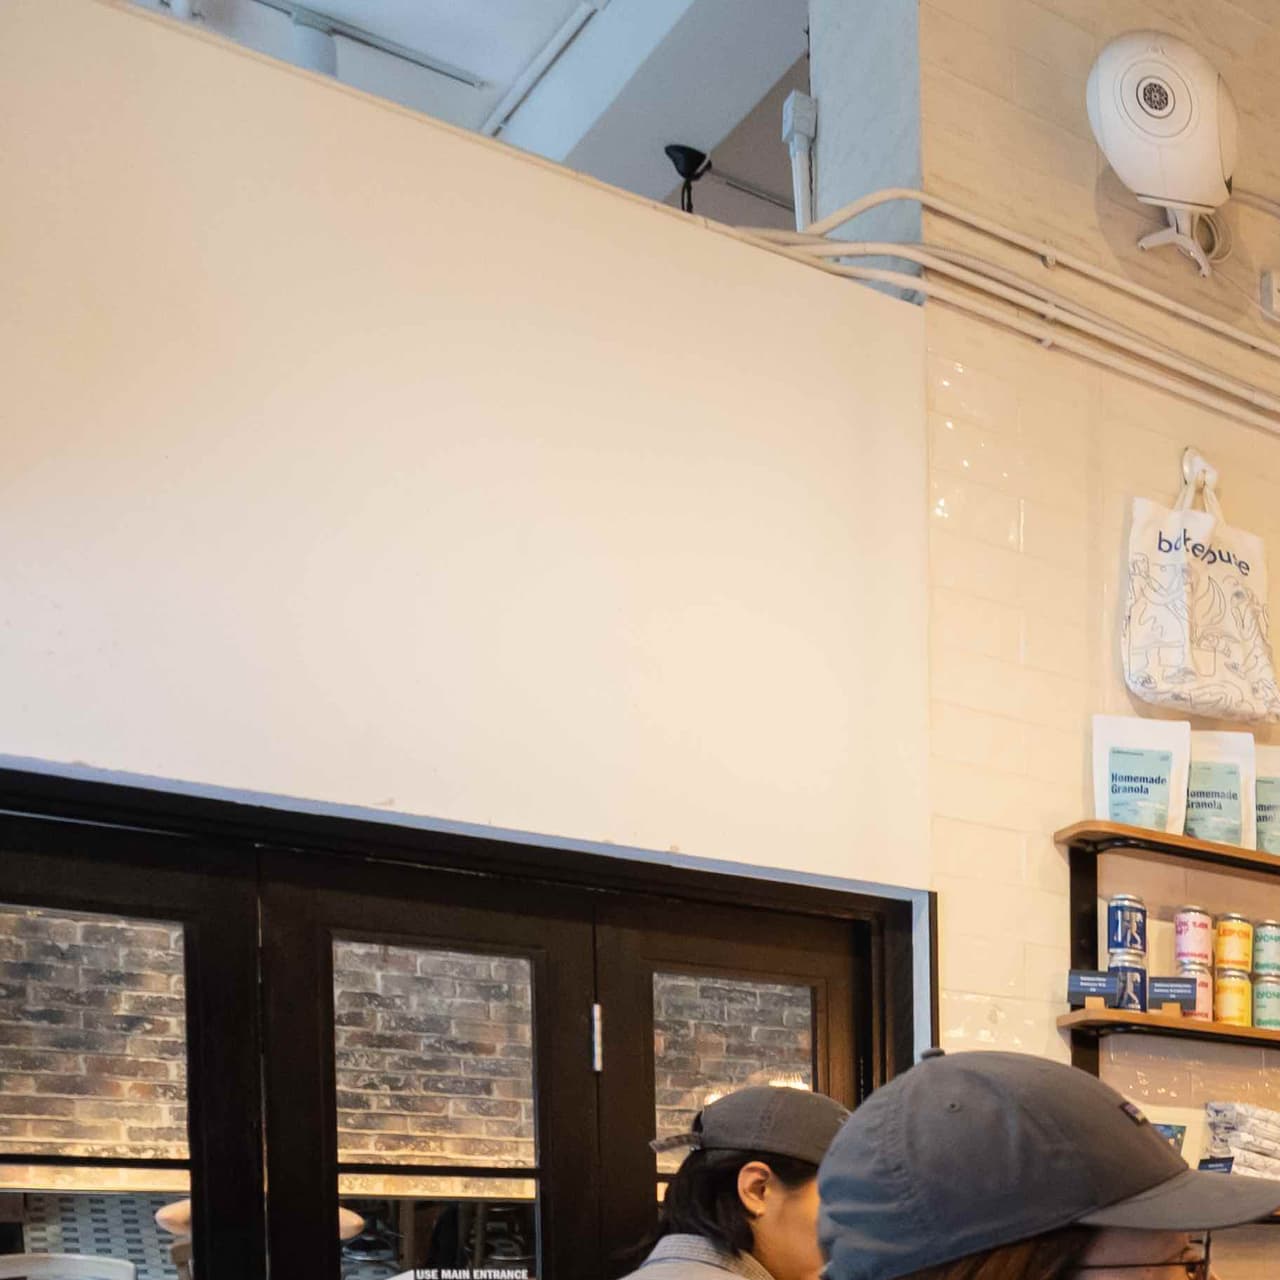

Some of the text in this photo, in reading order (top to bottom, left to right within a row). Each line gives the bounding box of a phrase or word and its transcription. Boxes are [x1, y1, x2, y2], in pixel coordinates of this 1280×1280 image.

[1111, 772, 1167, 785] Homemade
[1111, 784, 1149, 795] Granola
[416, 1269, 528, 1280] USE MAIN ENTRANCE
